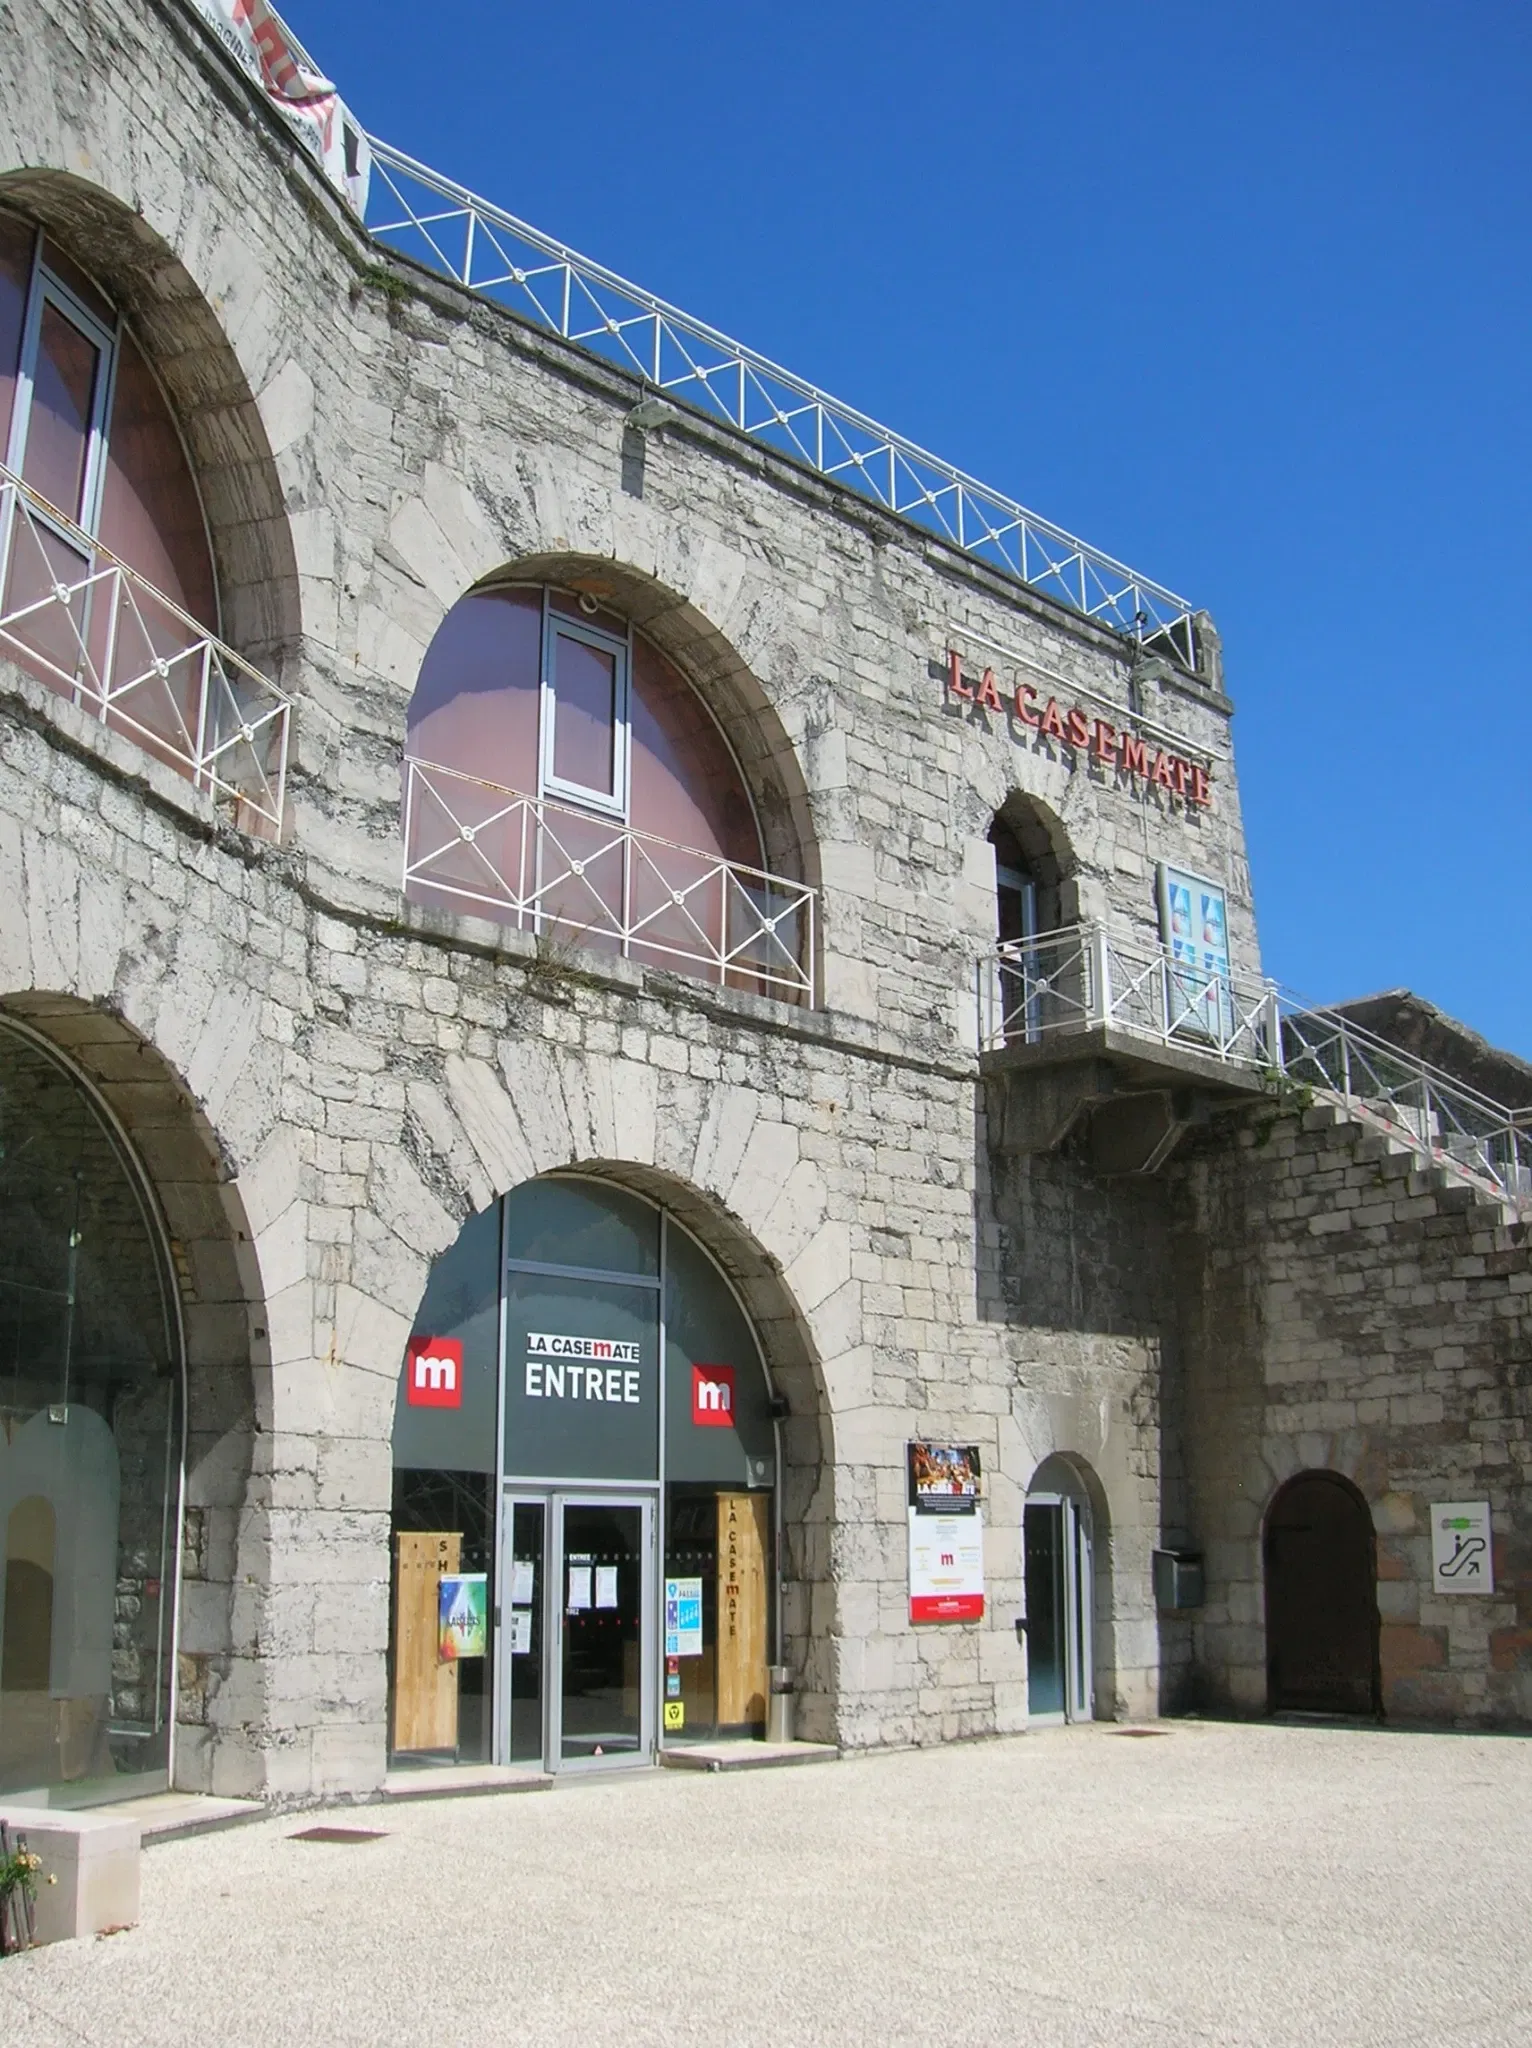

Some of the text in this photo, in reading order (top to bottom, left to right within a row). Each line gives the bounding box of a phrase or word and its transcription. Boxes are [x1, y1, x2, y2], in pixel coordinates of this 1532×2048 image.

[950, 650, 1211, 806] LA CASEMATE
[527, 1336, 547, 1352] LA
[525, 1362, 640, 1404] ENTREE
[728, 1499, 737, 1522] LA
